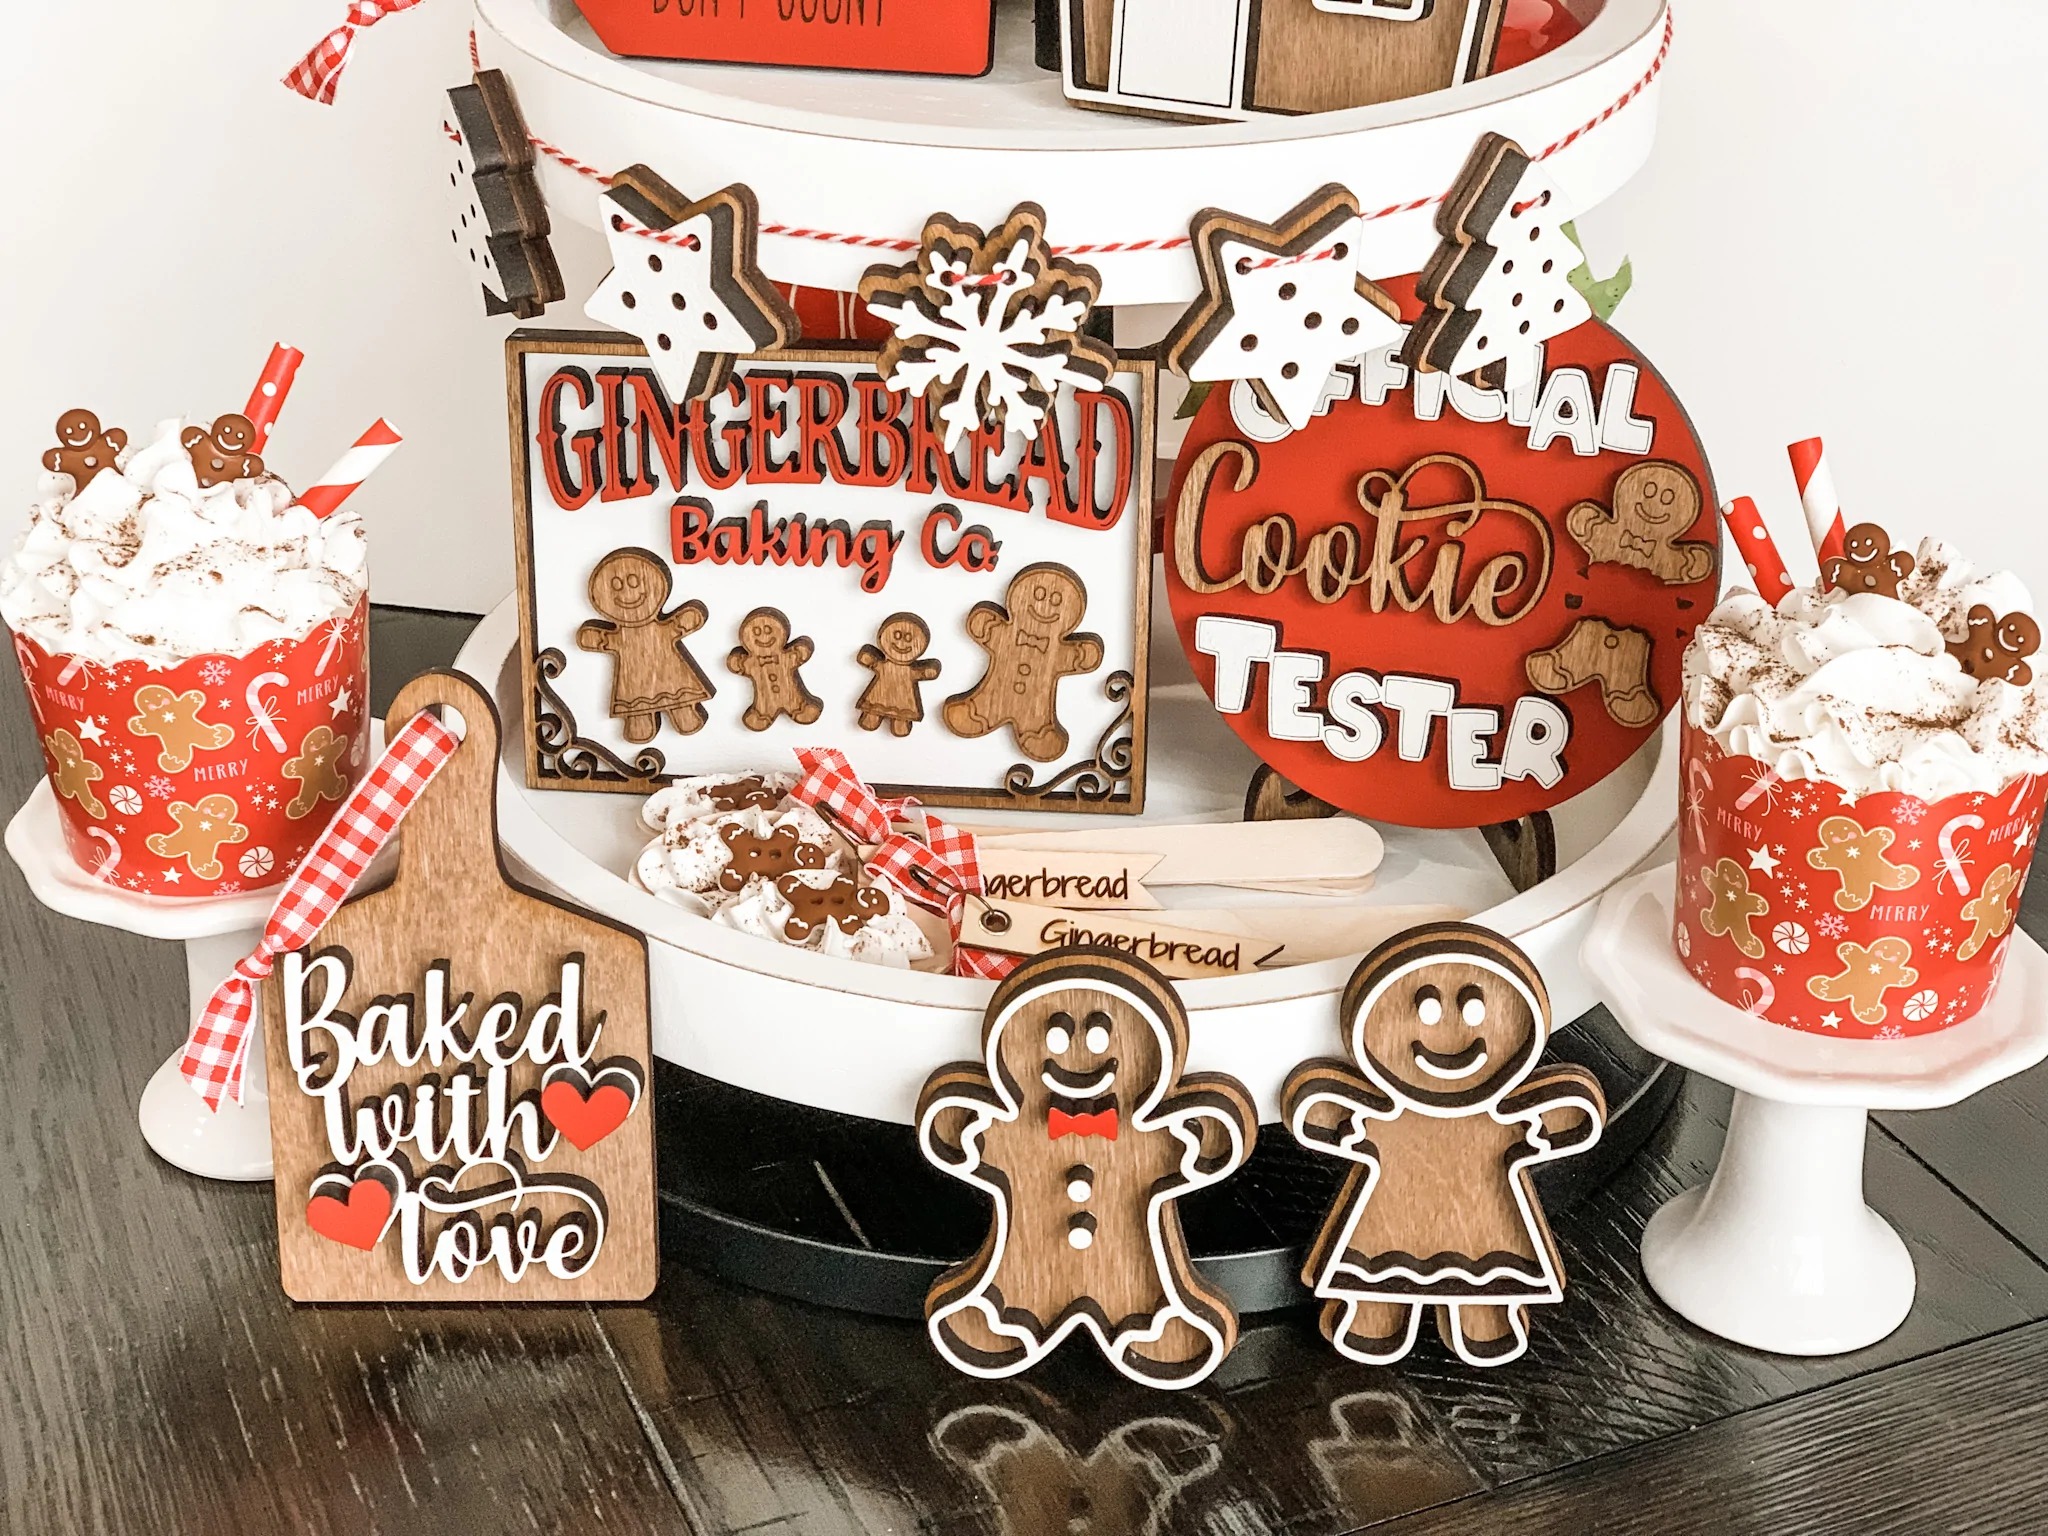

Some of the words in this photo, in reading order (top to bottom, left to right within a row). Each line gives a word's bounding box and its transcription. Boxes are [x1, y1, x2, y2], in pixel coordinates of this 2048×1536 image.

[536, 366, 1132, 531] GINGERBREAD
[671, 498, 903, 594] Baking
[1173, 441, 1555, 627] Cookie
[45, 685, 84, 712] MERRY
[297, 675, 340, 705] MERRY
[1195, 615, 1570, 790] TESTER
[194, 759, 249, 782] MERRY
[1717, 807, 1764, 842] MERRY
[1987, 813, 2027, 845] MERRY
[983, 867, 1129, 900] gerbread
[1870, 904, 1930, 922] MERRY
[283, 947, 605, 1097] Baked
[323, 1064, 562, 1166] with
[398, 1161, 606, 1285] love
